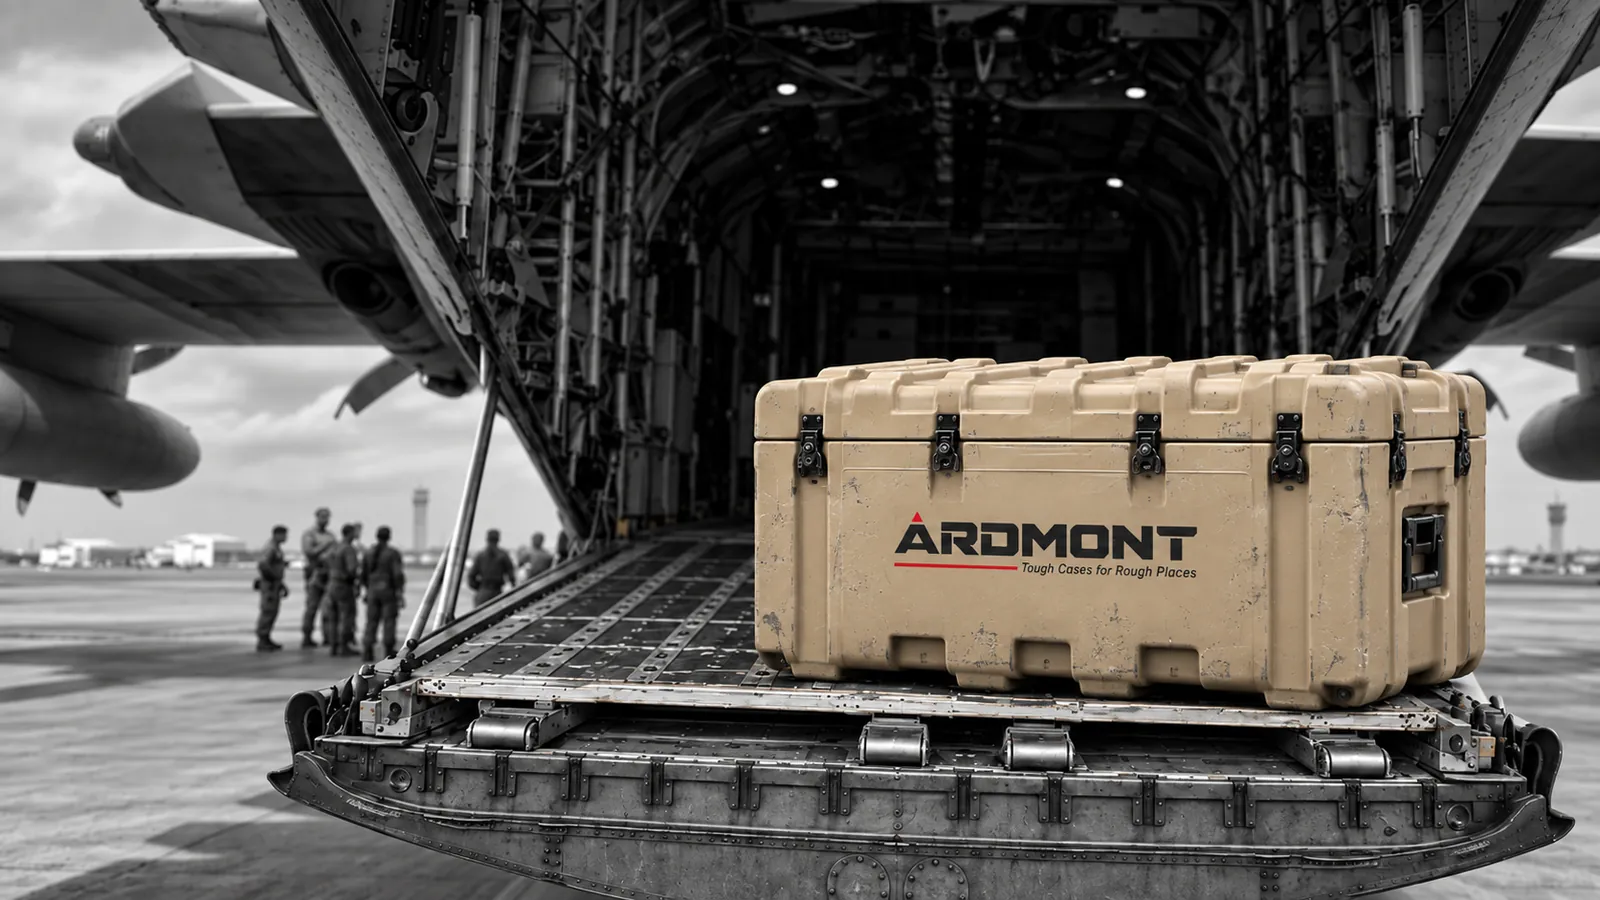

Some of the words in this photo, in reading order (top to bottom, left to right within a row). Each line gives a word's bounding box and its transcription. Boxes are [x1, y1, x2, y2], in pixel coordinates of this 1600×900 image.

[894, 512, 1198, 561] ARDMONT
[1022, 562, 1054, 576] Tough
[1058, 563, 1092, 575] Cases
[1095, 564, 1112, 576] for
[1115, 565, 1153, 580] Rough
[1156, 566, 1197, 579] Places
